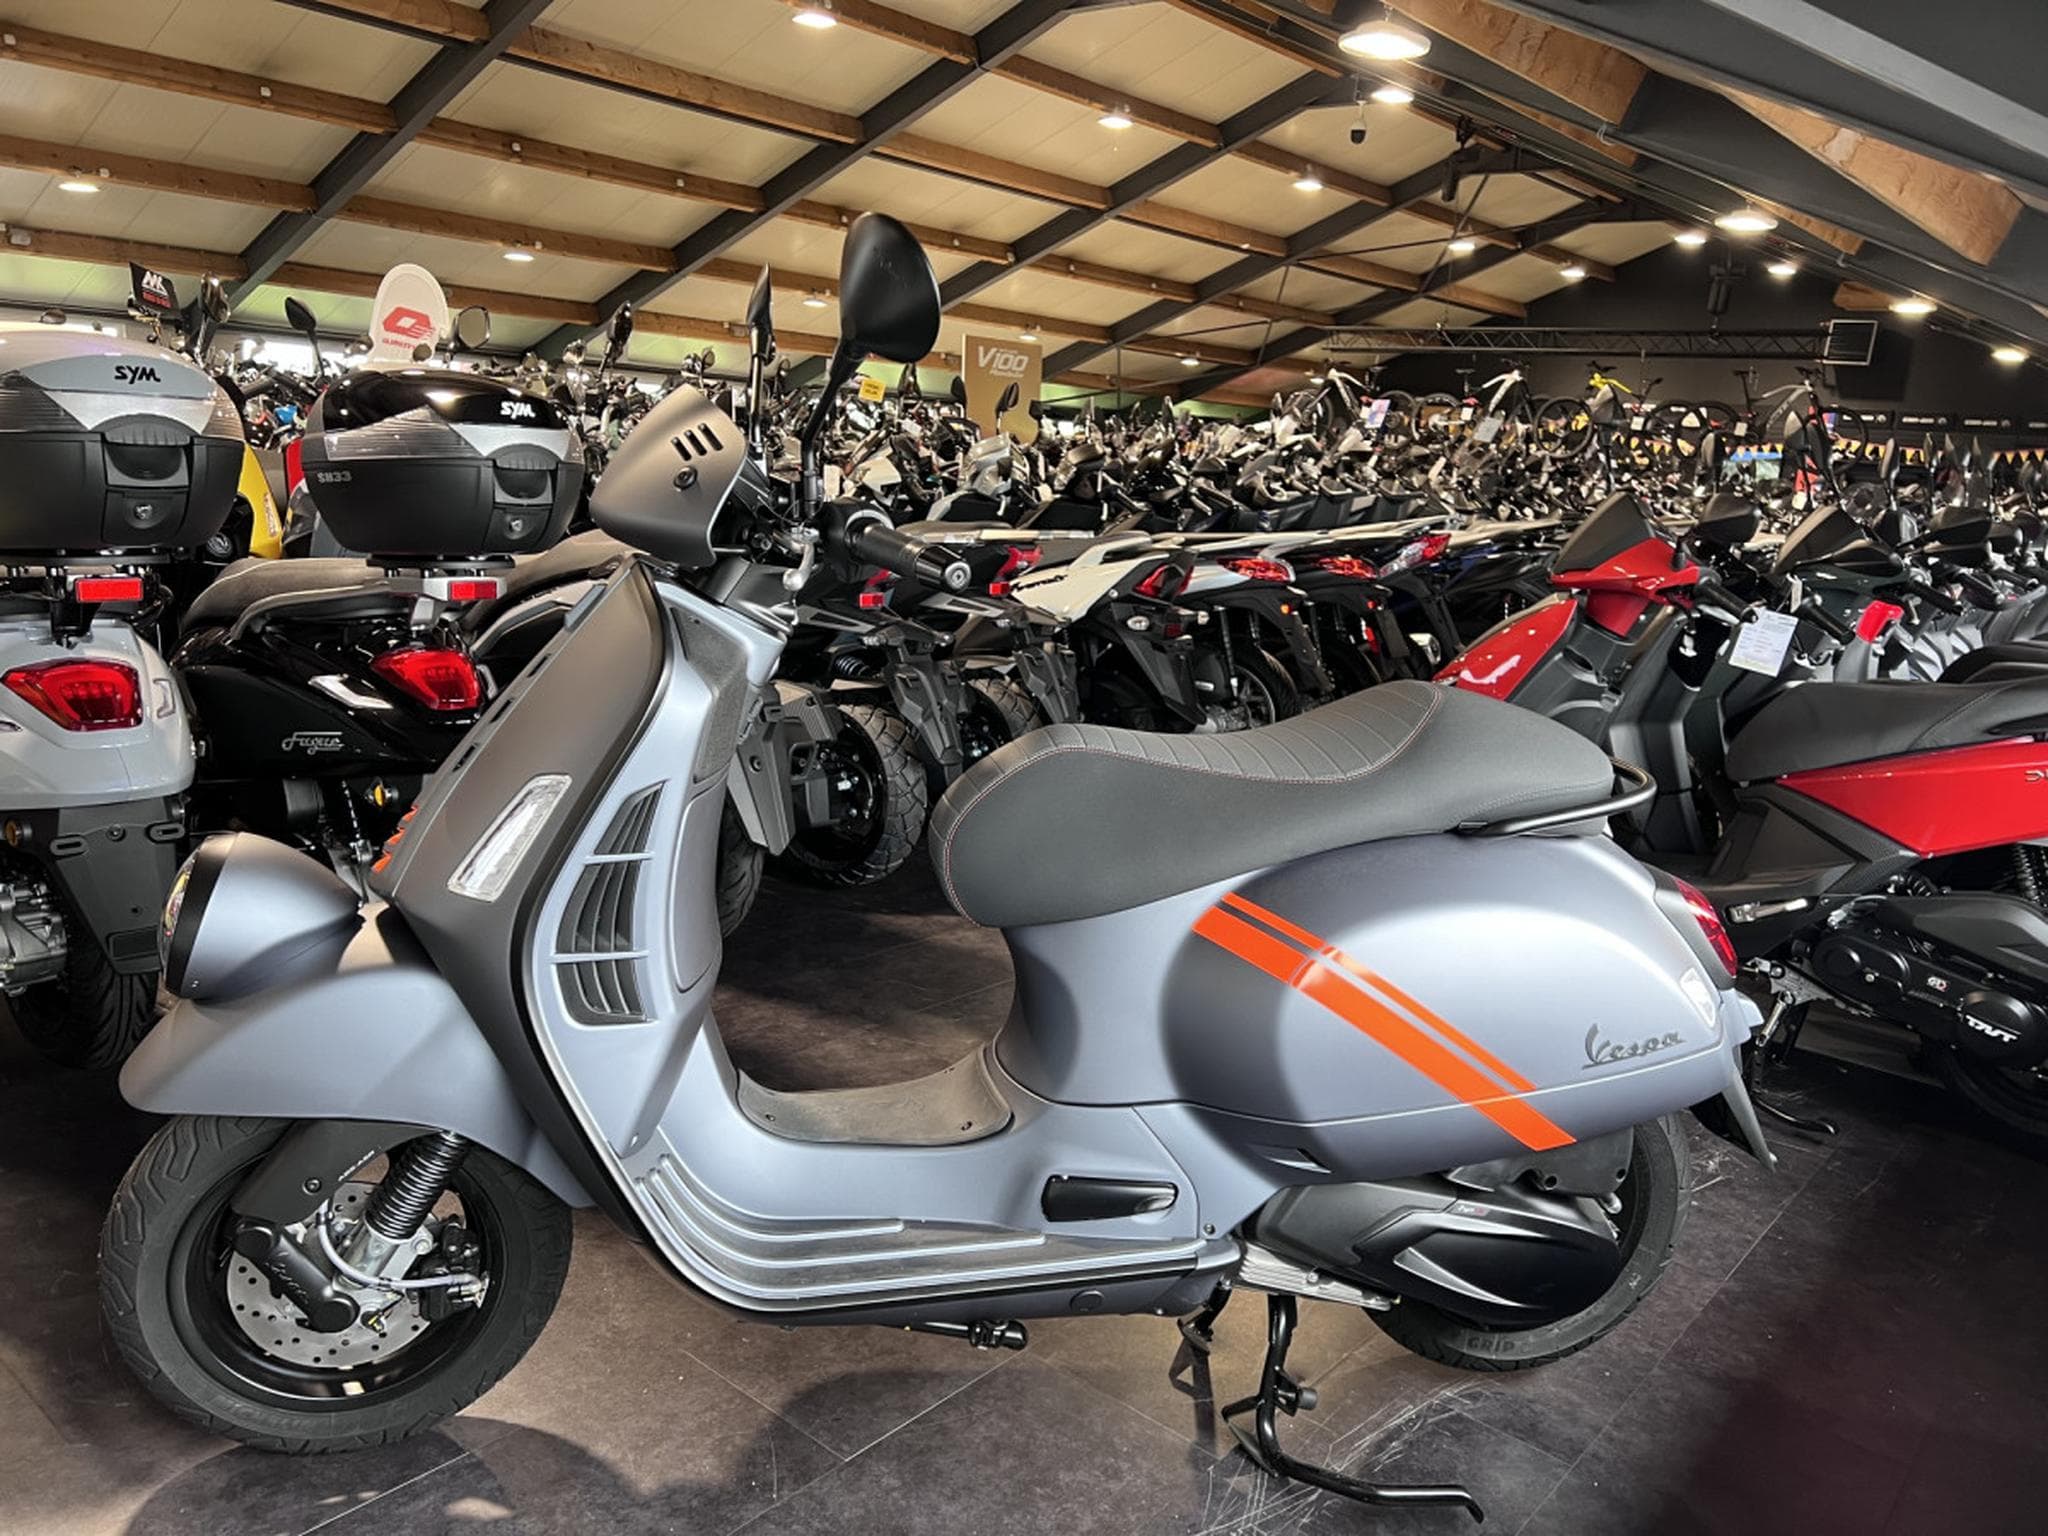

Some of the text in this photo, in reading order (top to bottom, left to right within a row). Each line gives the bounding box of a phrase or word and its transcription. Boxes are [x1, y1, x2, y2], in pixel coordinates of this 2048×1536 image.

[114, 365, 161, 384] SYM
[500, 401, 536, 419] SYM
[1581, 1023, 1687, 1069] Vespa
